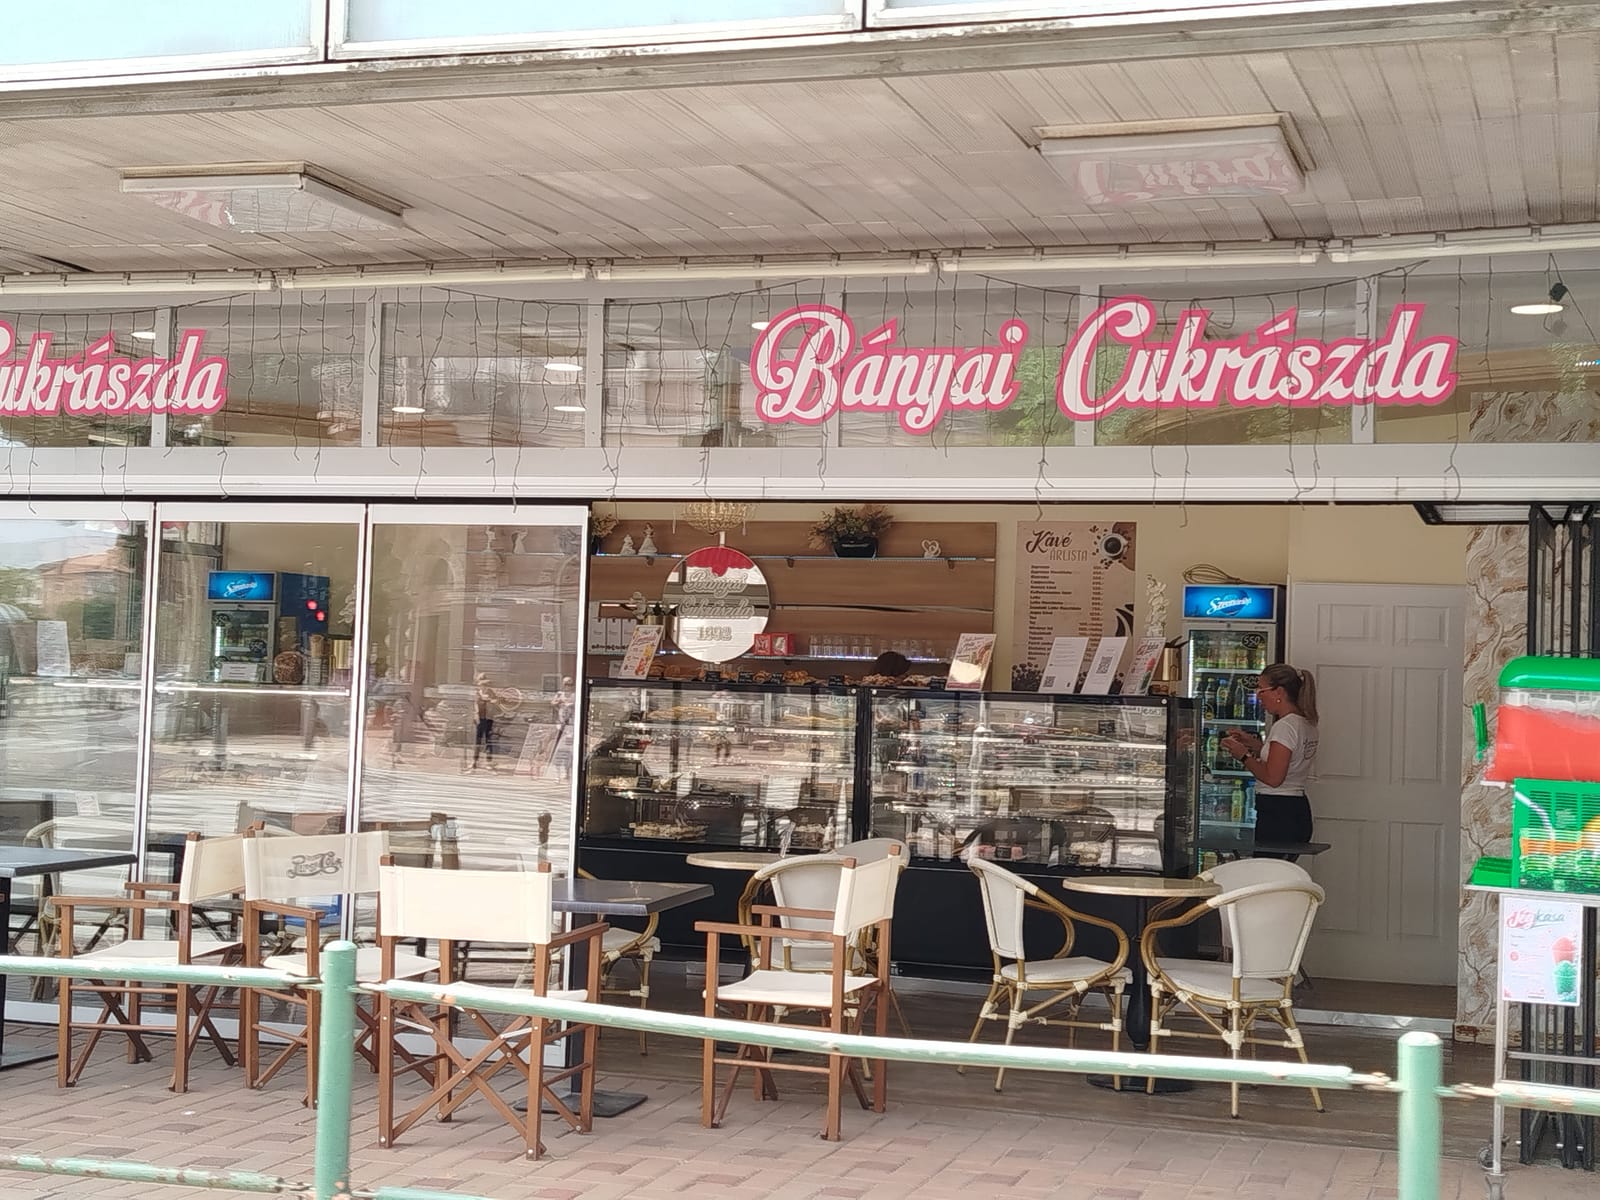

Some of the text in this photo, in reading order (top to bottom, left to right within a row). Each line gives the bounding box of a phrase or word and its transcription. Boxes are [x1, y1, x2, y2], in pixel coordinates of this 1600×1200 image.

[752, 296, 1459, 436] Bányai Cukrászda
[1026, 530, 1072, 553] Kávé
